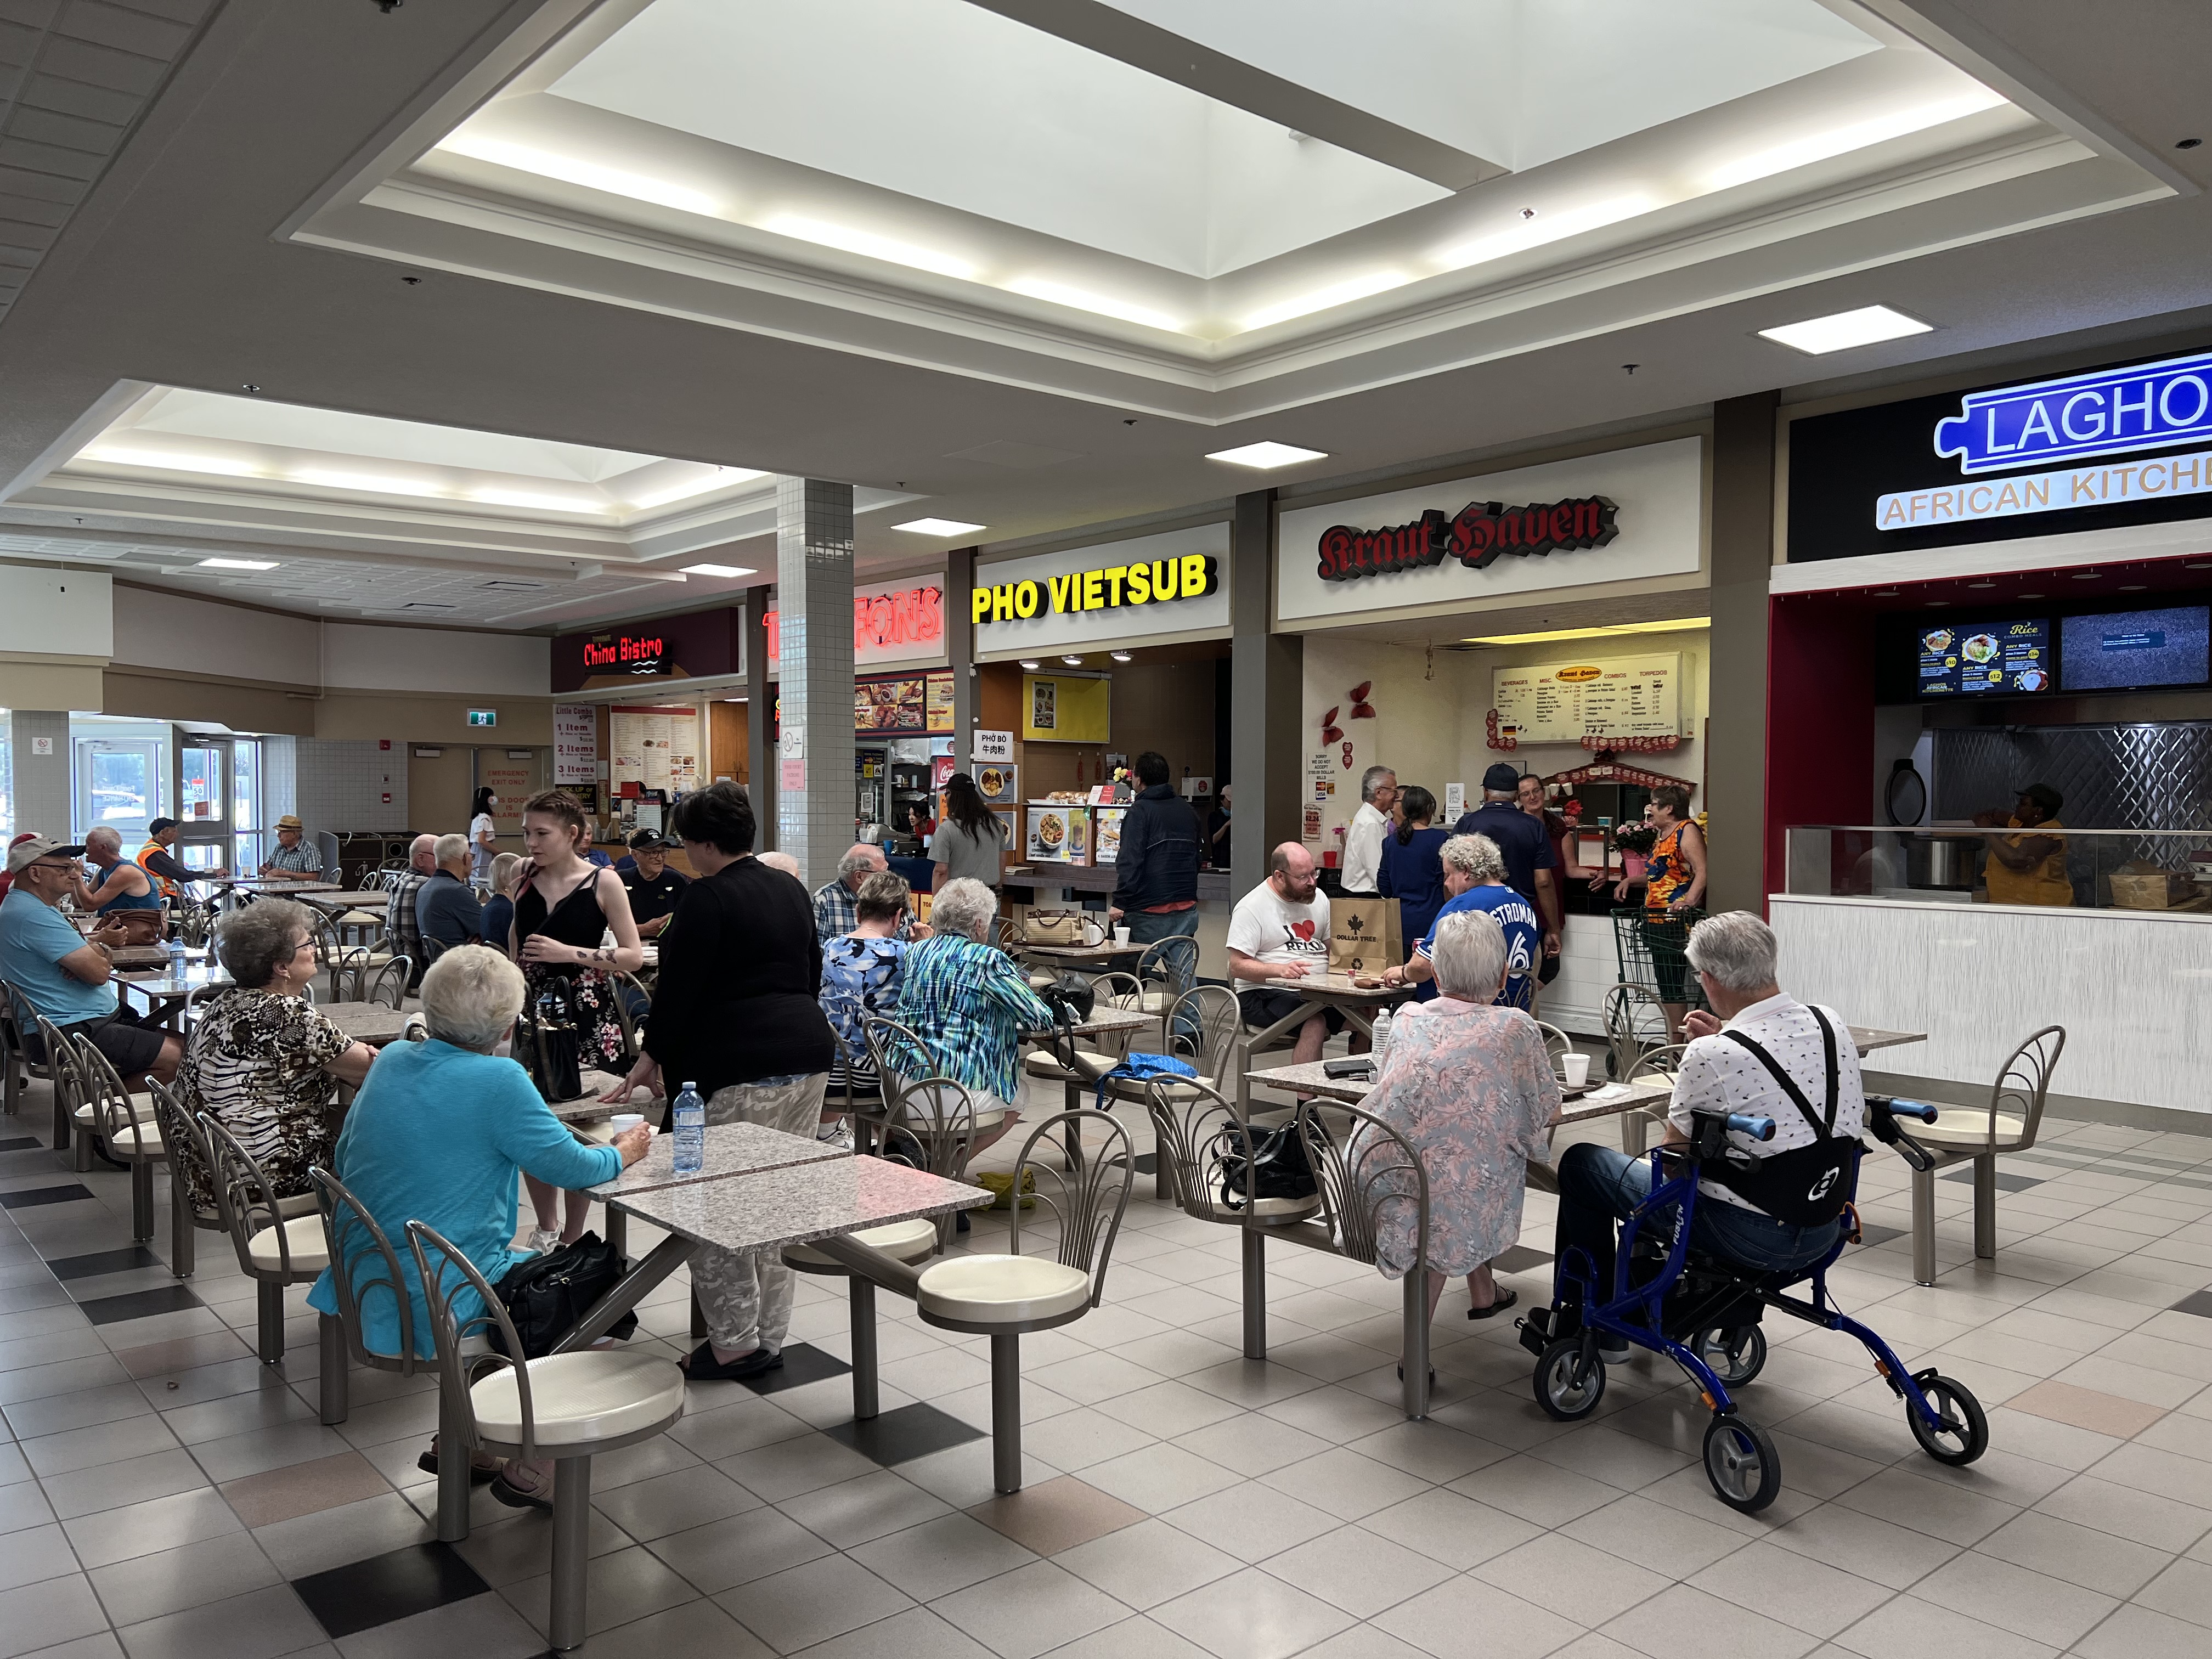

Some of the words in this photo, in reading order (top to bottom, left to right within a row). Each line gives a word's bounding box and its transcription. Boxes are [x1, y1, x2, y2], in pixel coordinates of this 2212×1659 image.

[1883, 478, 2049, 525] AFRICAN
[1321, 521, 1435, 578] Kraut
[1450, 500, 1602, 561] Haven
[972, 579, 1039, 624] PHO
[1048, 554, 1207, 614] VIETSUB
[2010, 624, 2039, 635] Rice
[584, 642, 616, 666] China
[620, 636, 662, 661] Bistro
[556, 706, 572, 714] Little
[566, 723, 588, 731] Item
[982, 744, 1006, 755] 牛肉粉
[1489, 902, 1537, 932] STROMAN
[1283, 925, 1295, 940] I
